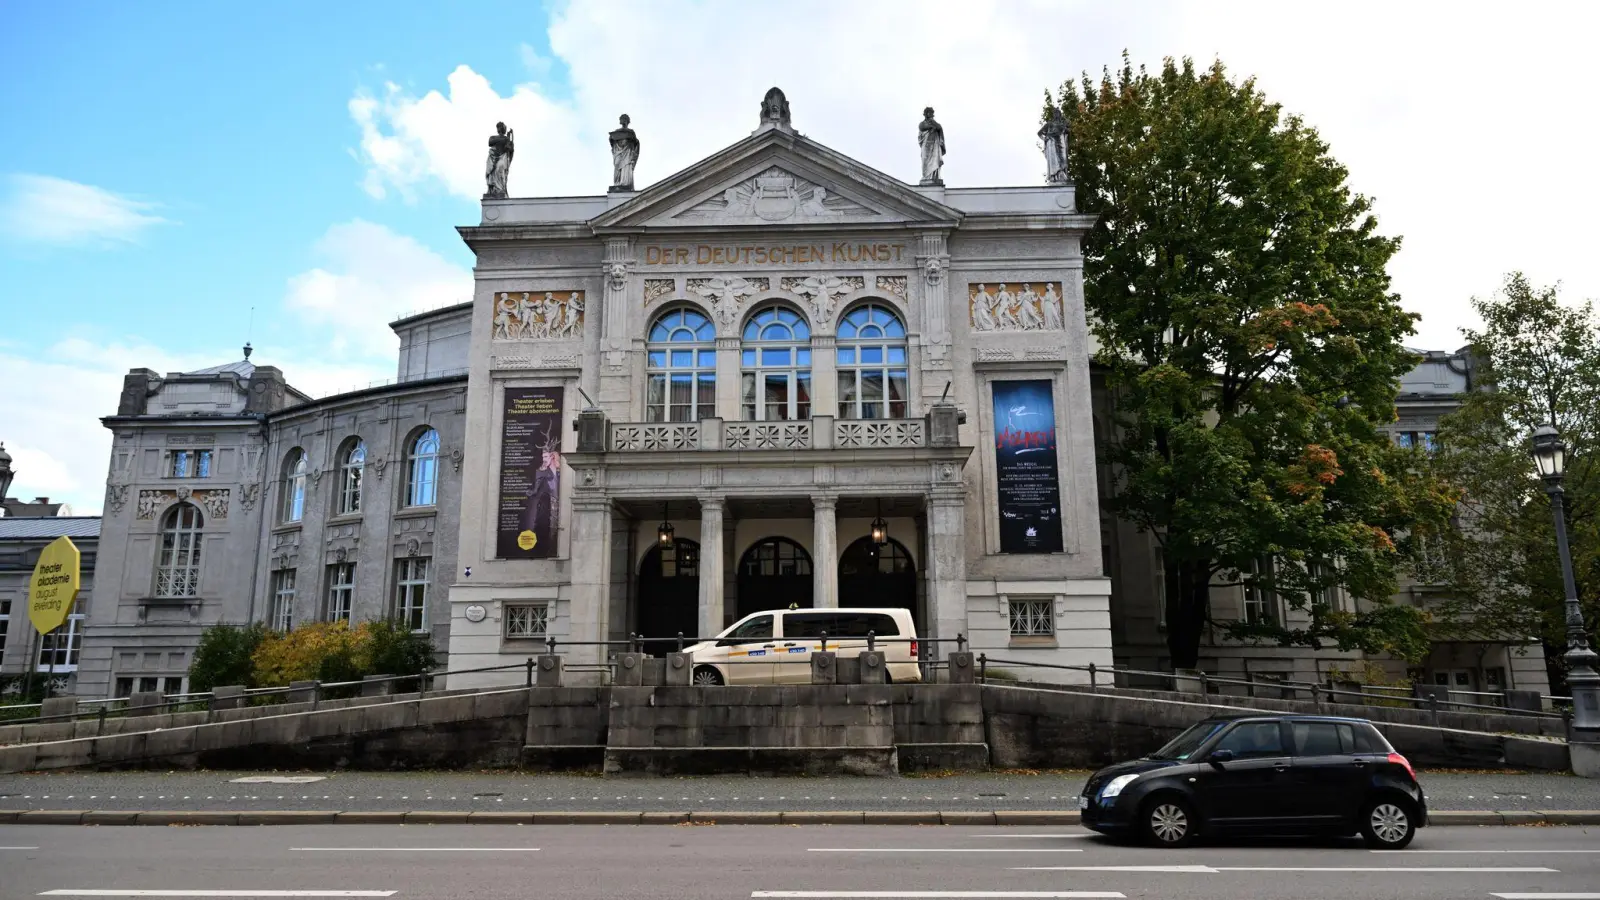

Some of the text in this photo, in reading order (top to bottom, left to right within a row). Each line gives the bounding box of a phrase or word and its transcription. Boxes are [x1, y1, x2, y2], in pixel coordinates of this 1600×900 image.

[646, 242, 906, 265] DER DEUTSCHEN KUNST
[40, 563, 63, 574] theater
[37, 573, 70, 587] akademie
[35, 588, 58, 600] august
[33, 600, 62, 612] everding
